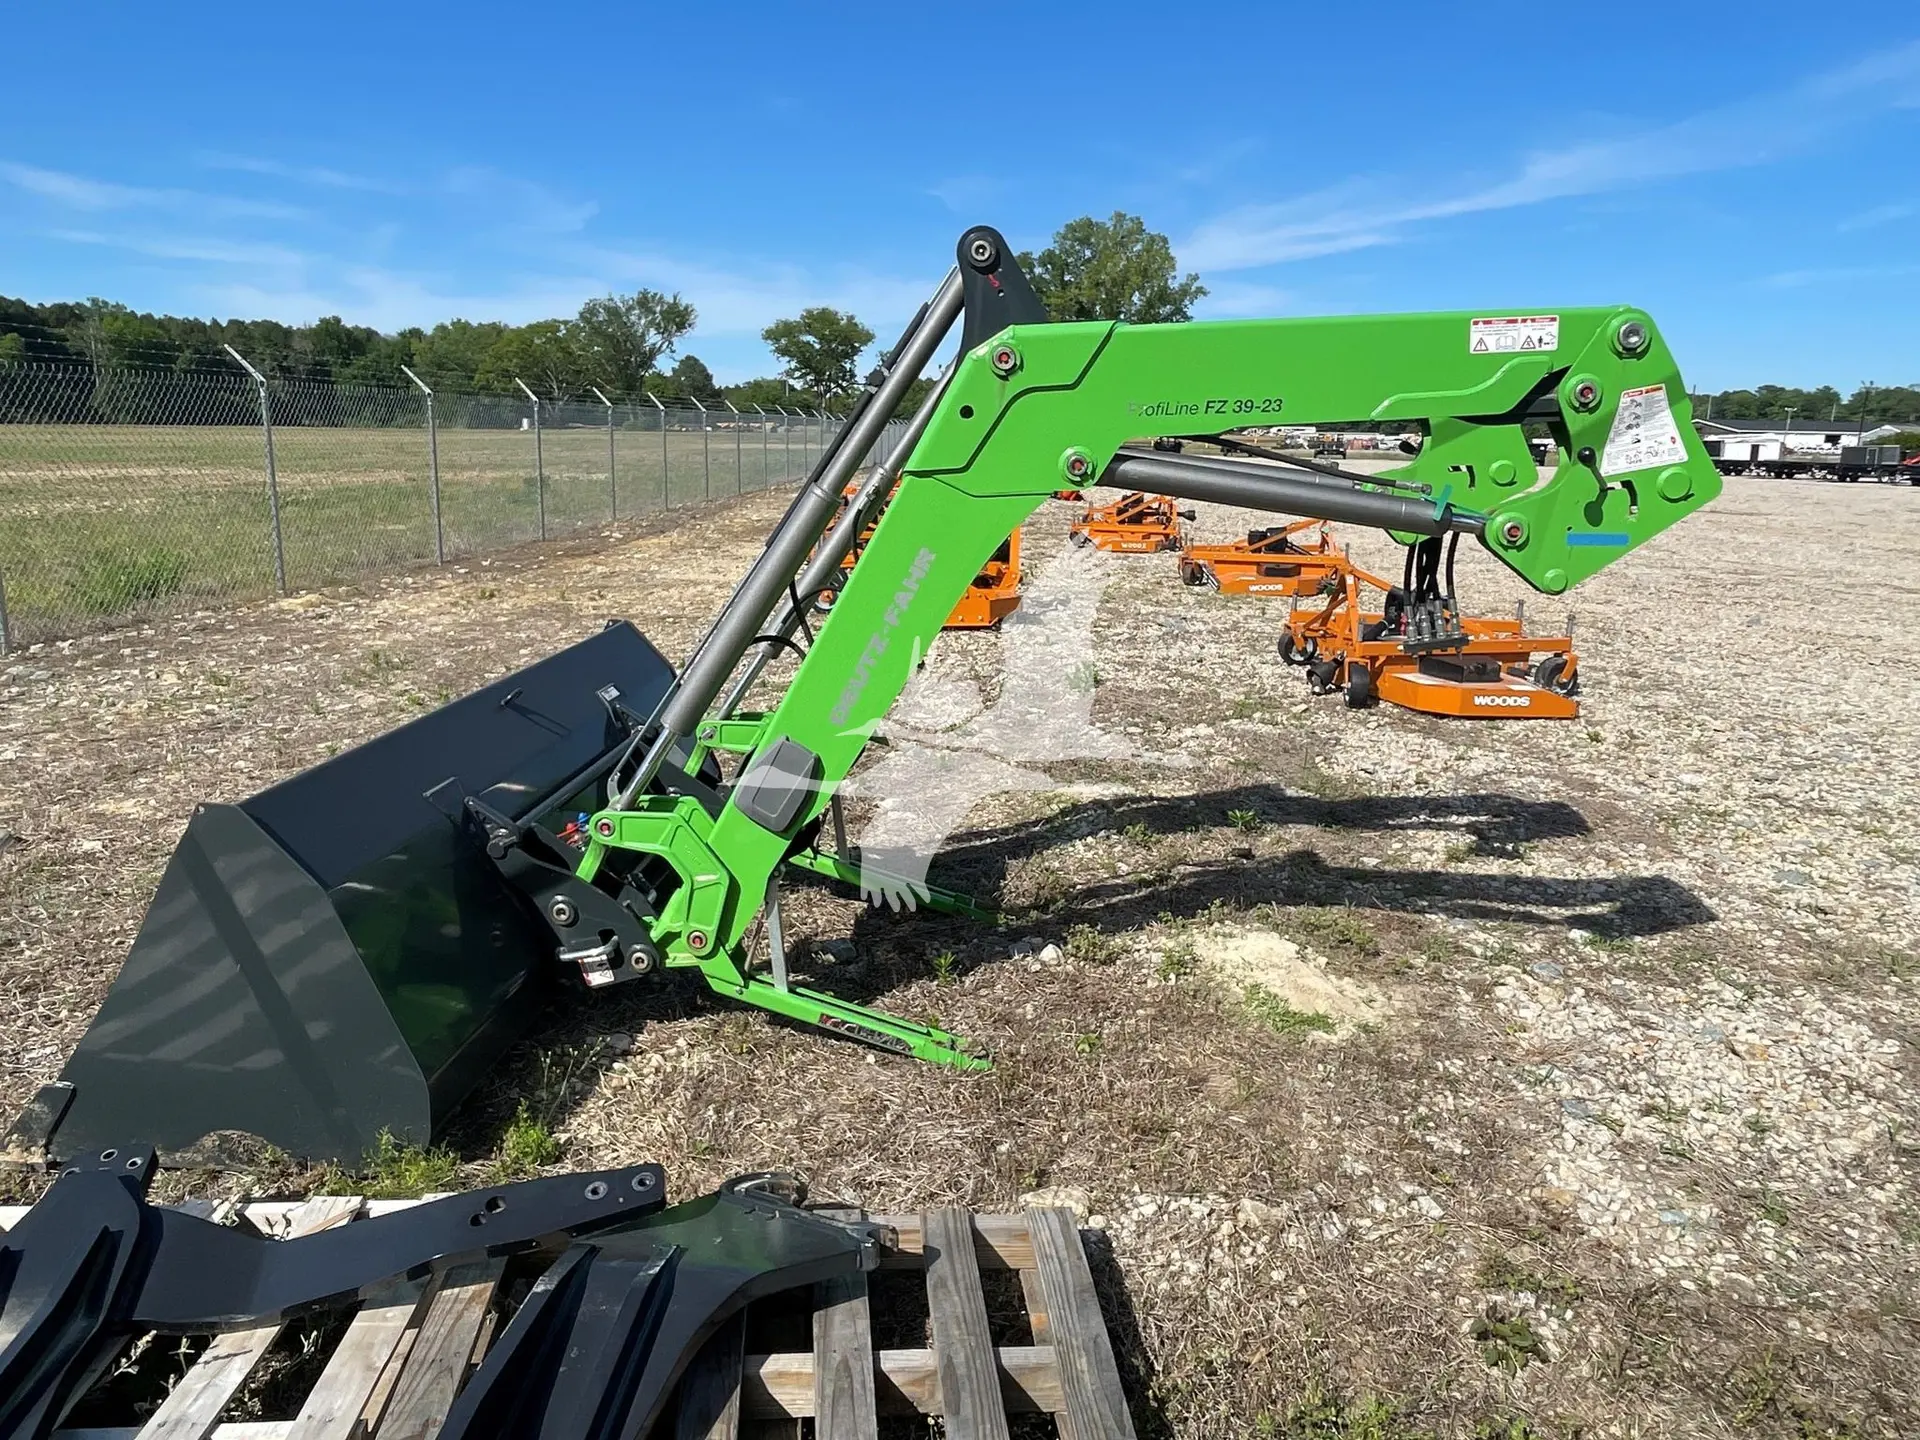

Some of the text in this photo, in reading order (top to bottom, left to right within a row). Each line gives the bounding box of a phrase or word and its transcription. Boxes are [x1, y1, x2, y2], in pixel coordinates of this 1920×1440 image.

[1204, 399, 1228, 414] FZ
[1232, 398, 1283, 414] 39-23
[1248, 583, 1283, 592] WOODS
[1473, 695, 1531, 707] WOODS
